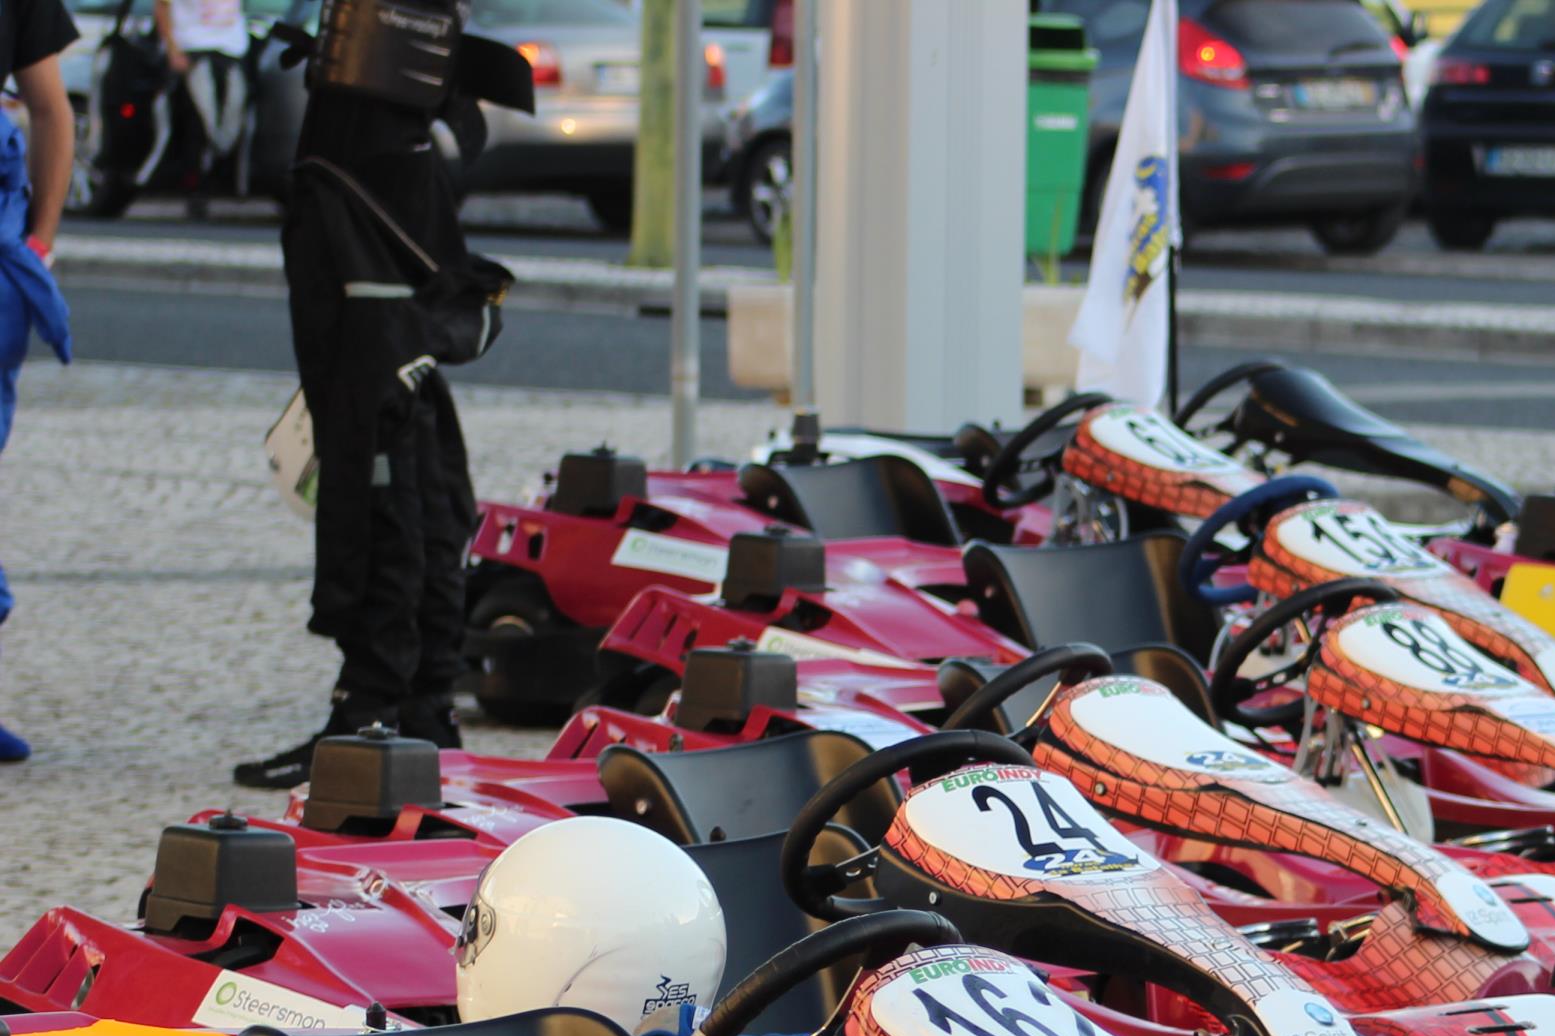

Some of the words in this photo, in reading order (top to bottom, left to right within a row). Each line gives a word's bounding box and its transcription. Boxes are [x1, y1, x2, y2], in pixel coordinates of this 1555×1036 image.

[1381, 620, 1484, 673] 88
[941, 767, 1043, 793] EUROINDY
[971, 781, 1110, 857] 24
[1034, 850, 1107, 870] 24
[908, 958, 1012, 984] EUROINDY
